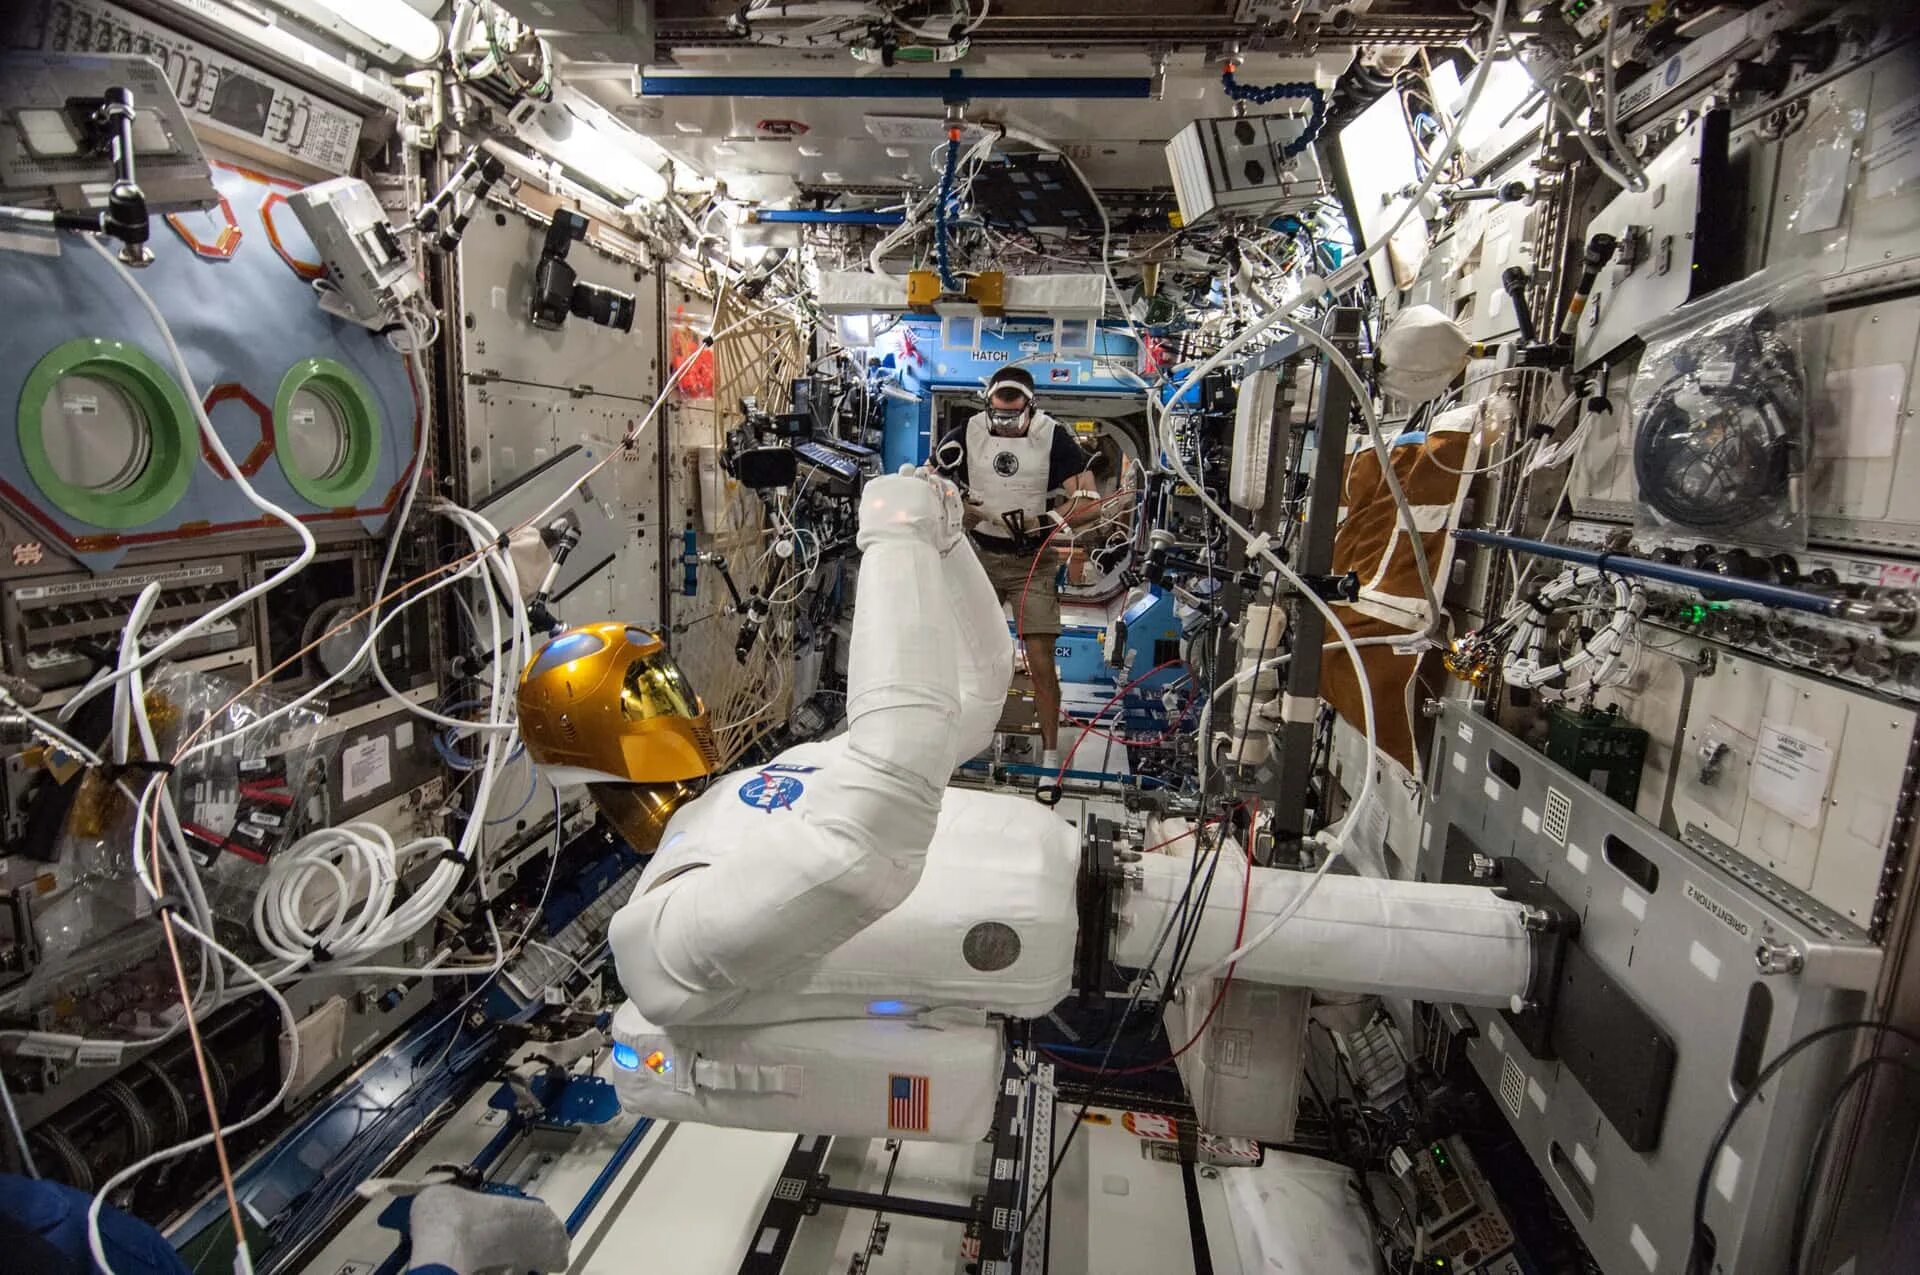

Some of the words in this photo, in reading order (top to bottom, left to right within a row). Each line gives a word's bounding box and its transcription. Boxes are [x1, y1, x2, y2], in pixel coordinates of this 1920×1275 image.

[972, 351, 1008, 361] HATCH
[1687, 885, 1694, 897] 2
[1693, 890, 1748, 937] ORIENTATION
